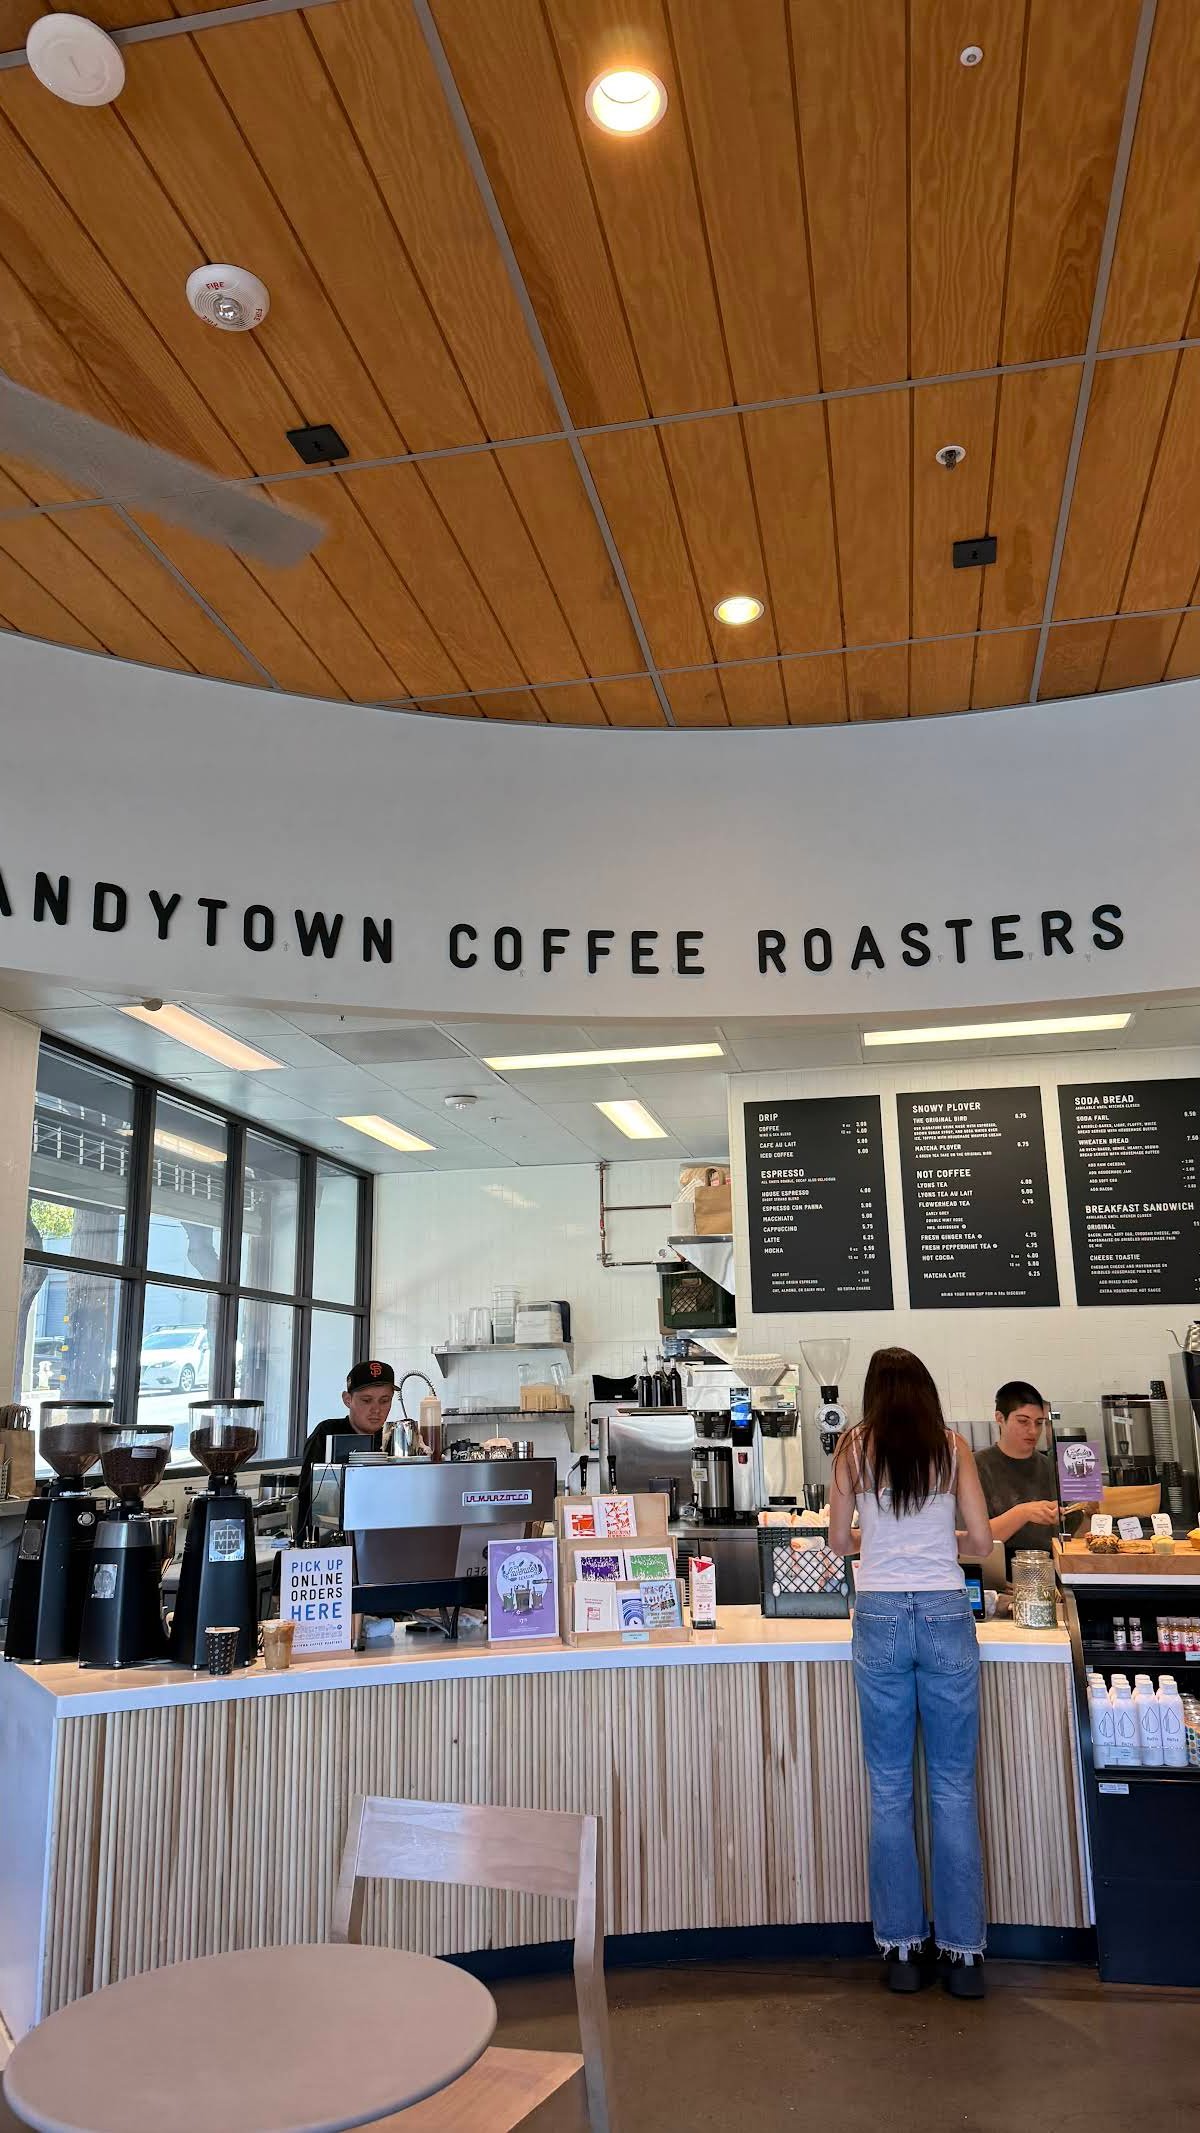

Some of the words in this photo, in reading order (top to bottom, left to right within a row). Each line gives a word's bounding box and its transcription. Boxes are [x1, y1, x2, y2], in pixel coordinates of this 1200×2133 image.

[206, 281, 224, 290] FIRE
[450, 923, 704, 975] COFFEE
[758, 904, 1124, 974] ROASTERS
[1074, 1096, 1100, 1106] SODA
[1103, 1095, 1134, 1104] BREAD
[912, 1104, 944, 1113] SNOWY
[947, 1102, 981, 1112] PLOVER
[759, 1113, 778, 1122] DRIP
[1078, 1138, 1107, 1146] WHEATEN
[761, 1169, 804, 1178] ESPRESSO
[916, 1170, 934, 1179] NOT
[936, 1169, 971, 1178] COFFEE
[1085, 1204, 1140, 1214] BREAKFAST
[1143, 1202, 1194, 1212] SANDWICH
[292, 1560, 321, 1573] PICK
[327, 1560, 343, 1570] UP
[292, 1572, 343, 1588] ONLINE
[291, 1587, 343, 1602] ORDERS
[291, 1602, 342, 1622] HERE
